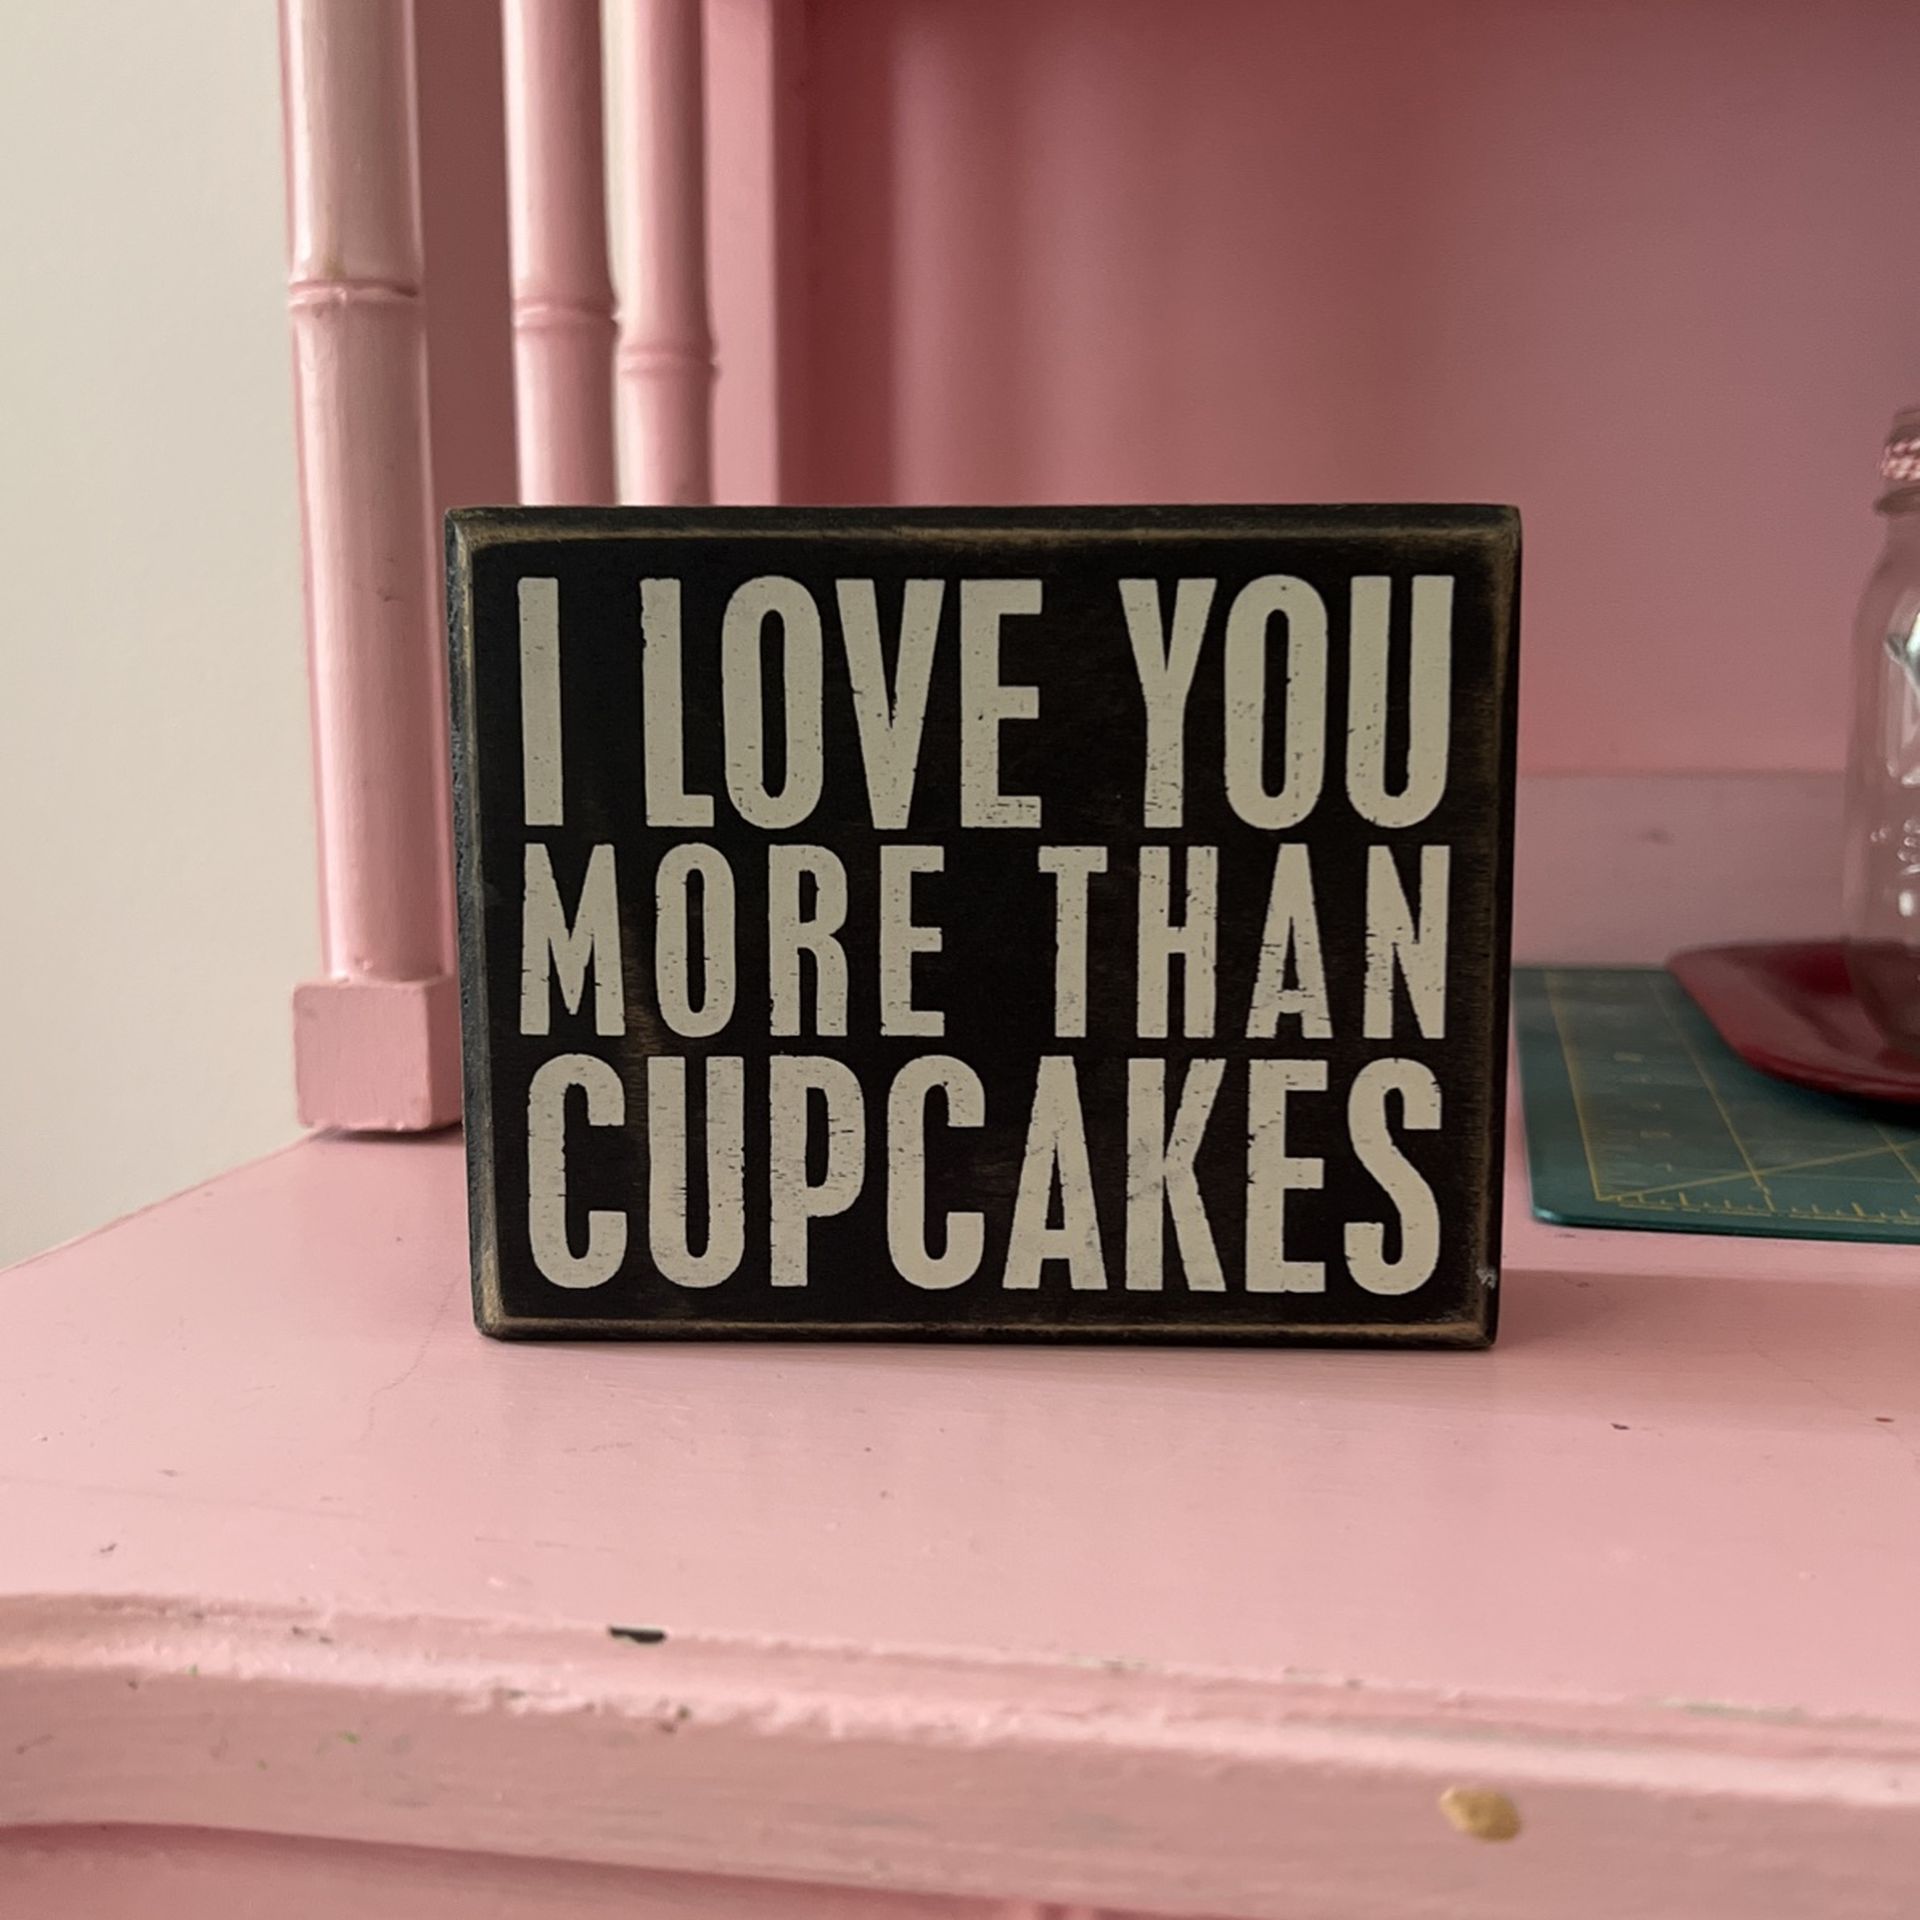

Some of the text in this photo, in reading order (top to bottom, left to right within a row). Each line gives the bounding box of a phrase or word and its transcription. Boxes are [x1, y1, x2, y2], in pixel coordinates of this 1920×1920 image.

[518, 576, 1454, 831] I LOVE YOU
[520, 843, 1451, 1040] MORE THAN
[526, 1054, 1442, 1295] CUPCAKES
